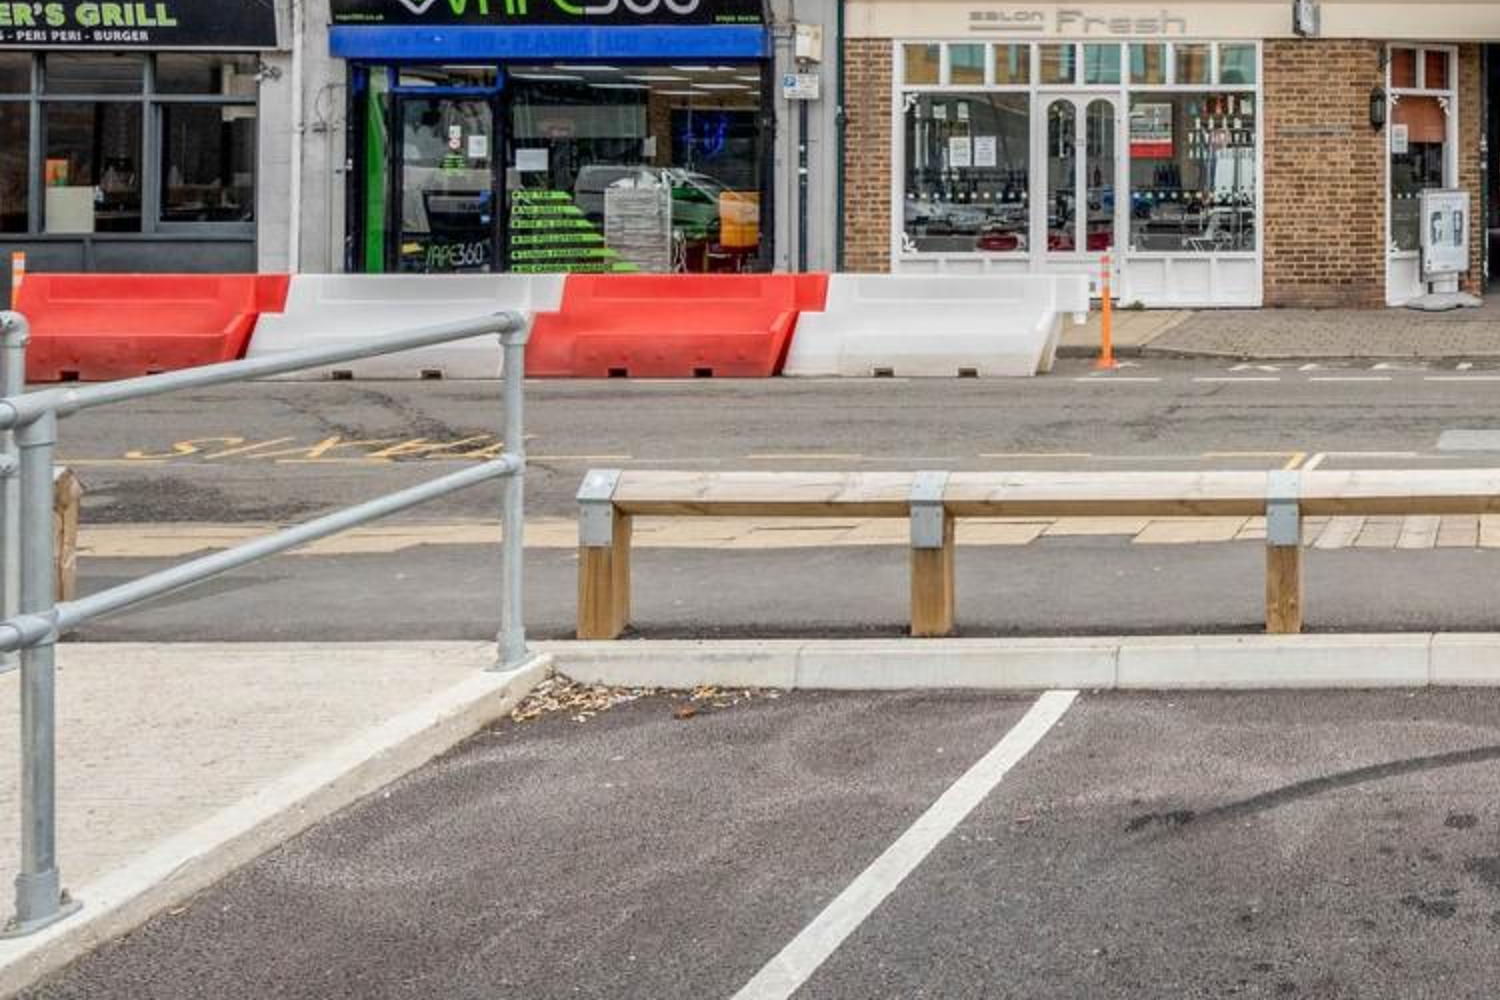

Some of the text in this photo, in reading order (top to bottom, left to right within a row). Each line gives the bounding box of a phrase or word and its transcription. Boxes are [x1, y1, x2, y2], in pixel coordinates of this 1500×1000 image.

[75, 2, 177, 26] GRILL
[1055, 8, 1187, 35] Fresh
[16, 30, 47, 41] PERI
[51, 30, 82, 41] PERI
[94, 30, 149, 41] BURGER
